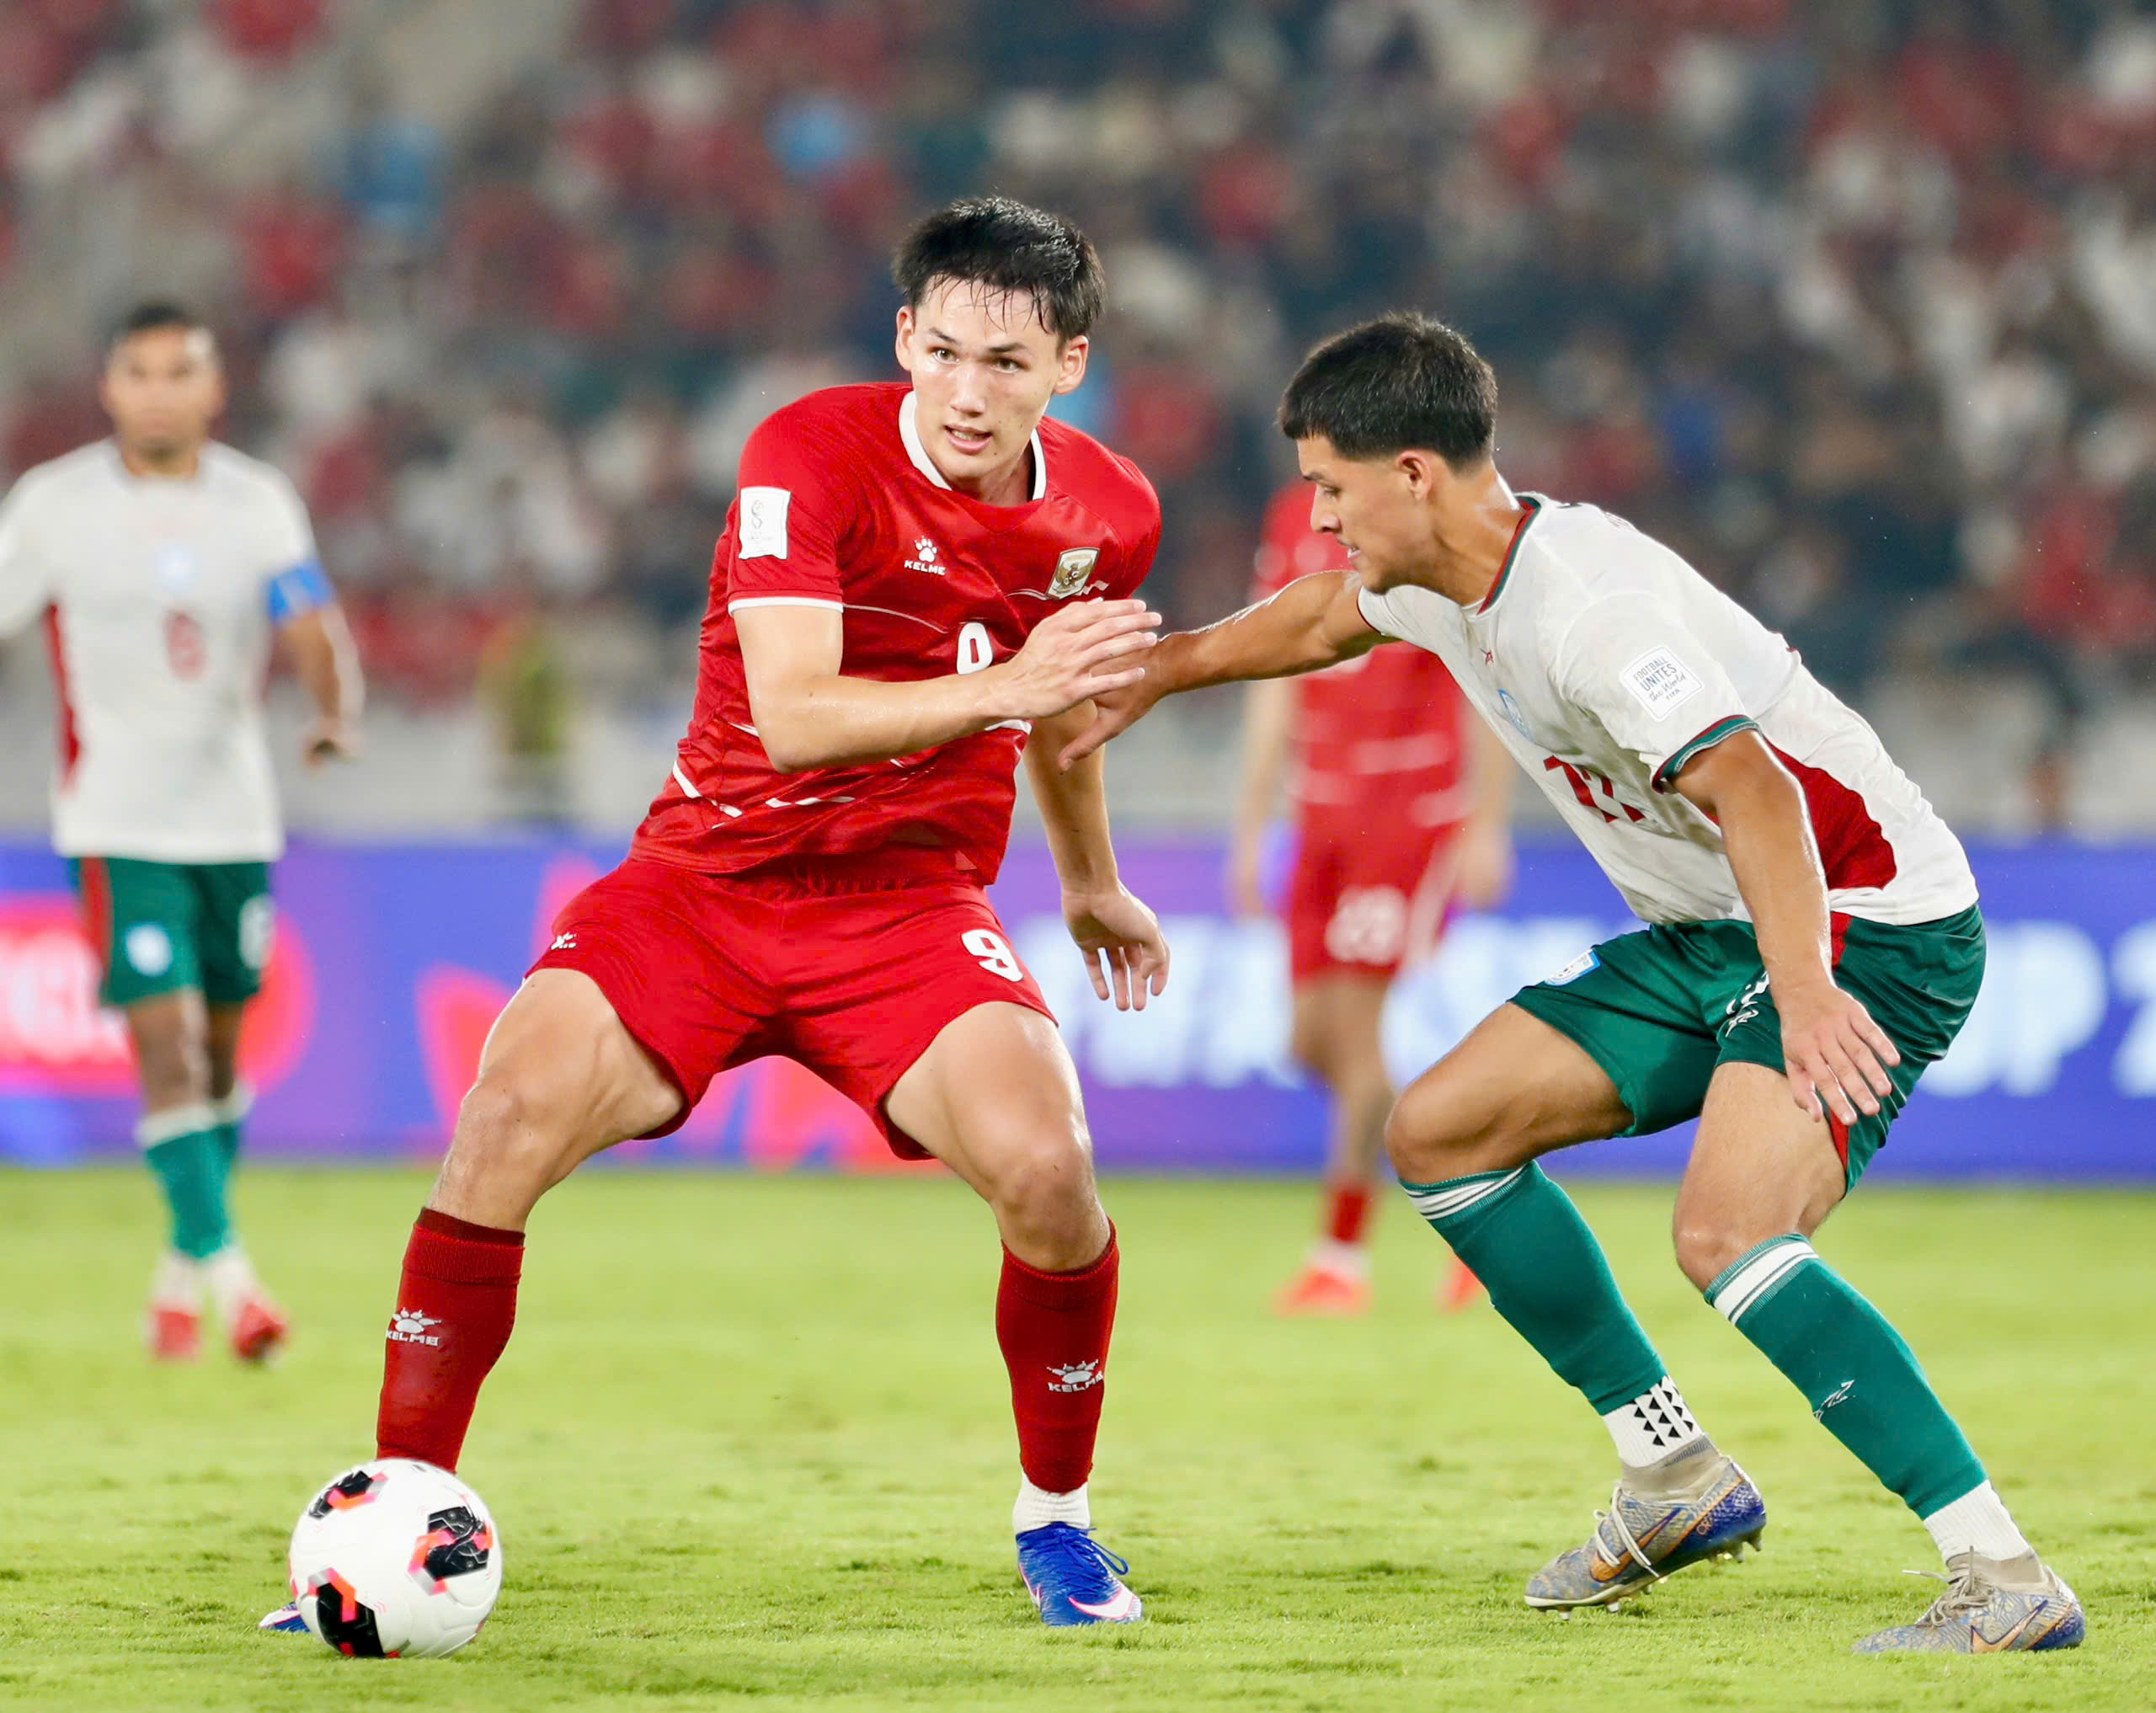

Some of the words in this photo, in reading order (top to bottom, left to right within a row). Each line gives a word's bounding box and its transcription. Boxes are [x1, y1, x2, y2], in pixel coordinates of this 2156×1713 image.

[904, 559, 947, 576] KELME
[1633, 656, 1669, 681] FOOTBALL
[1640, 663, 1678, 691] UNITES
[961, 929, 1024, 982] 9
